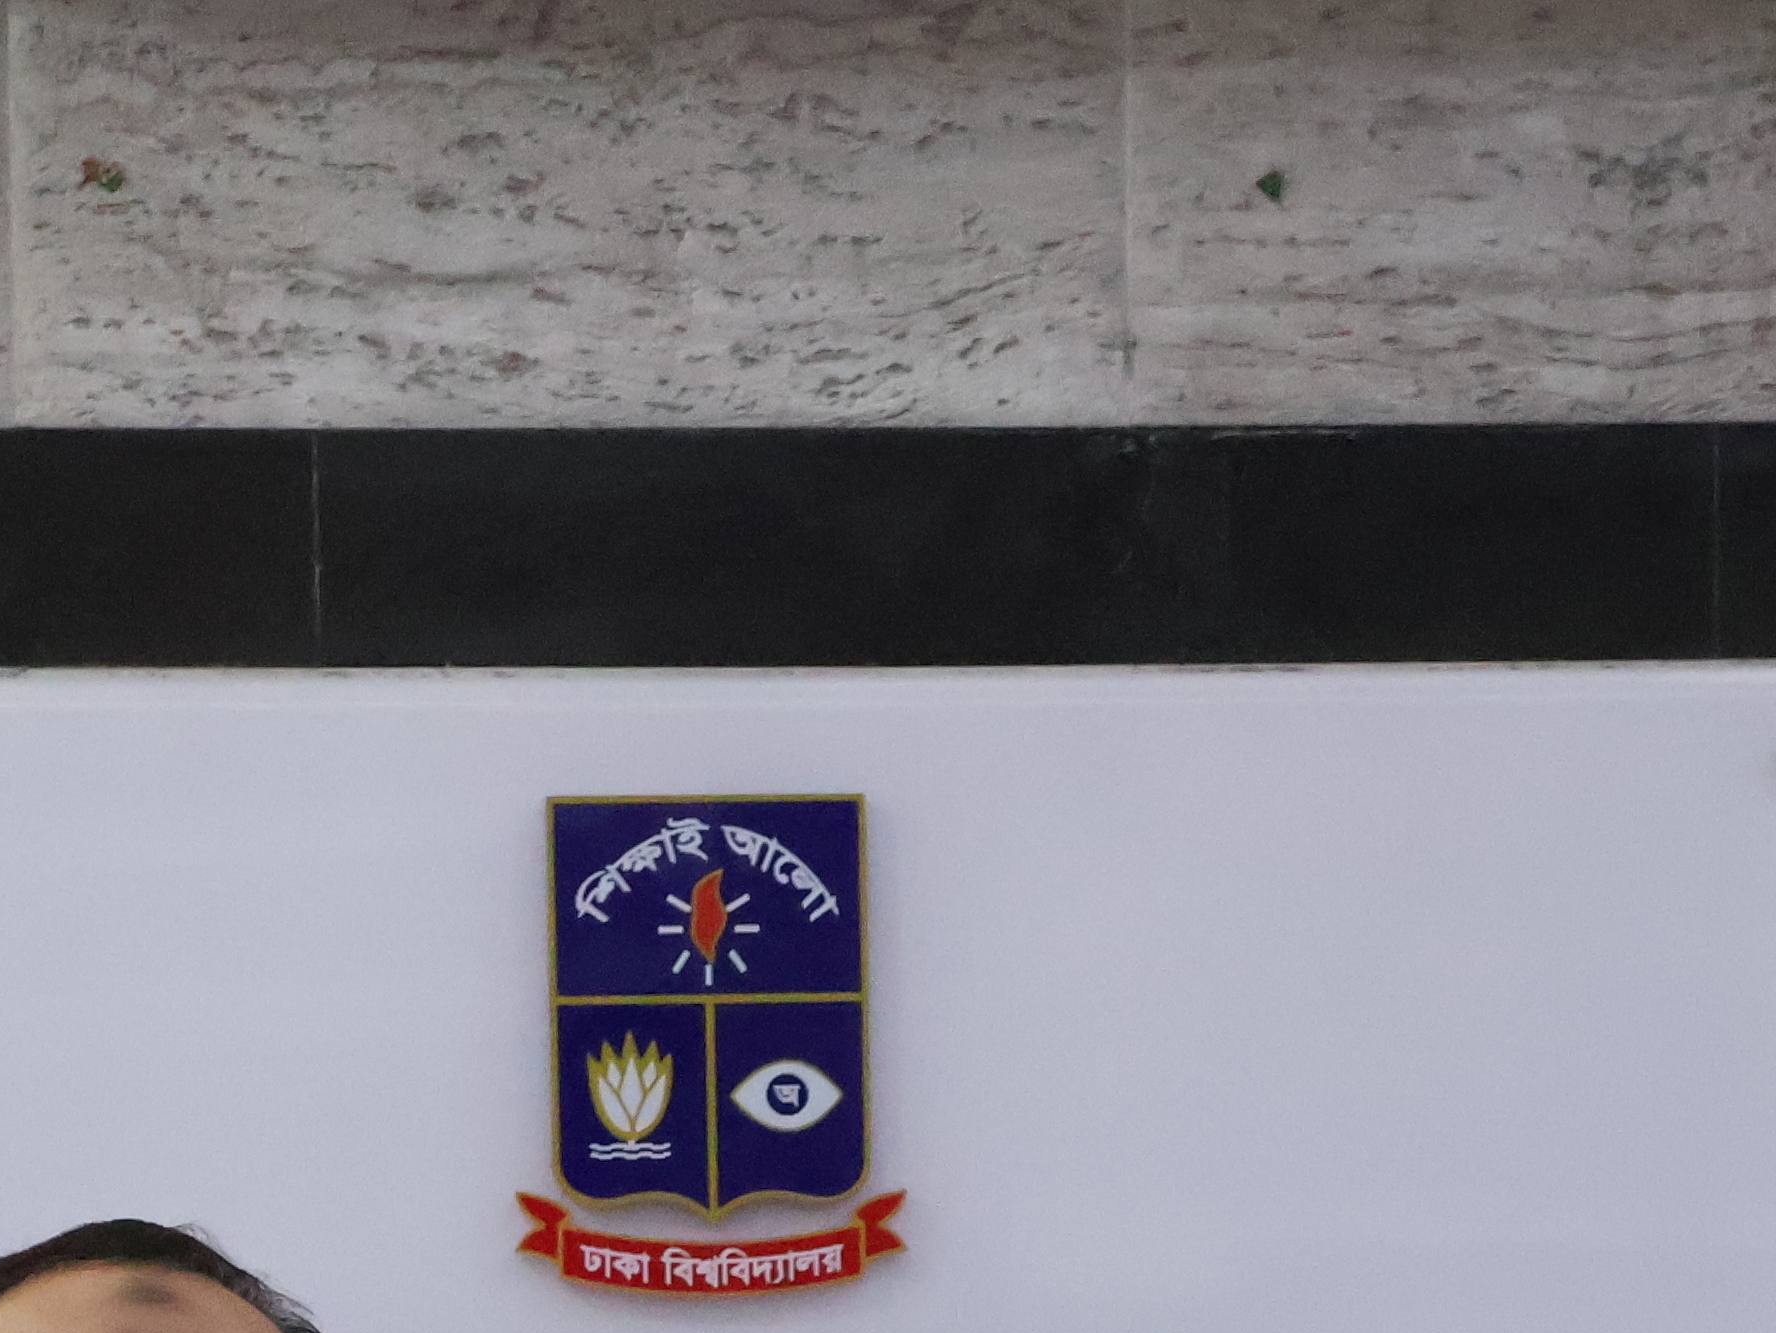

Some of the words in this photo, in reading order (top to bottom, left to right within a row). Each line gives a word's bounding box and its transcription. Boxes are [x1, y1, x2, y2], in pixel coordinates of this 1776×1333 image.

[575, 817, 711, 923] শিক্ষাই
[720, 824, 840, 923] আলো
[579, 1244, 651, 1285] ঢাকা
[660, 1243, 845, 1289] বিশ্ববিদ্যালয়
